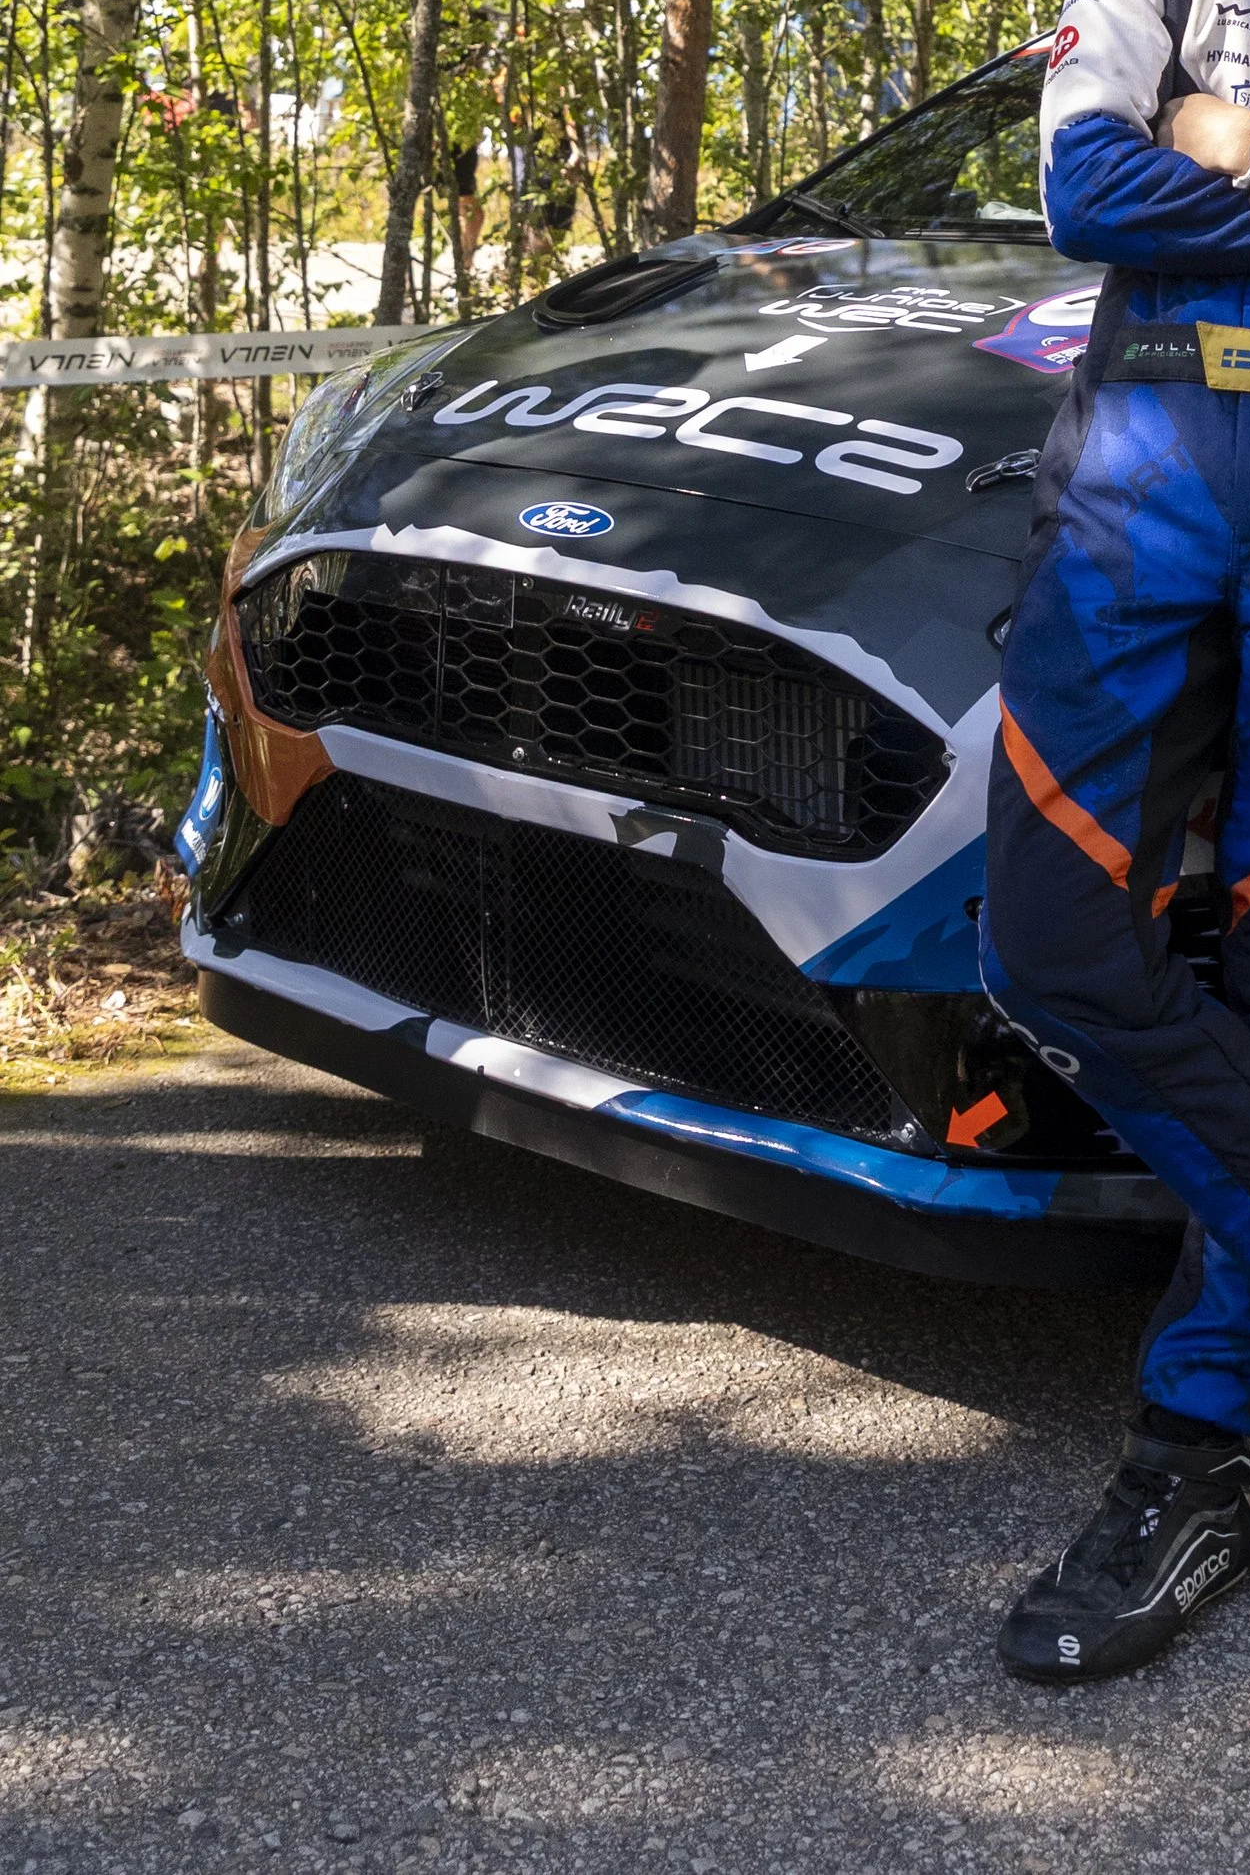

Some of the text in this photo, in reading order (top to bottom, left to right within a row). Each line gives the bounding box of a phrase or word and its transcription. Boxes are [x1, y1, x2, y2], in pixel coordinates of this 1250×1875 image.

[757, 299, 986, 334] WRC
[808, 290, 996, 315] JUNIOR
[1138, 342, 1196, 353] FULL
[433, 379, 964, 495] WRC2
[528, 503, 602, 536] Ford
[1174, 1548, 1231, 1614] sparco
